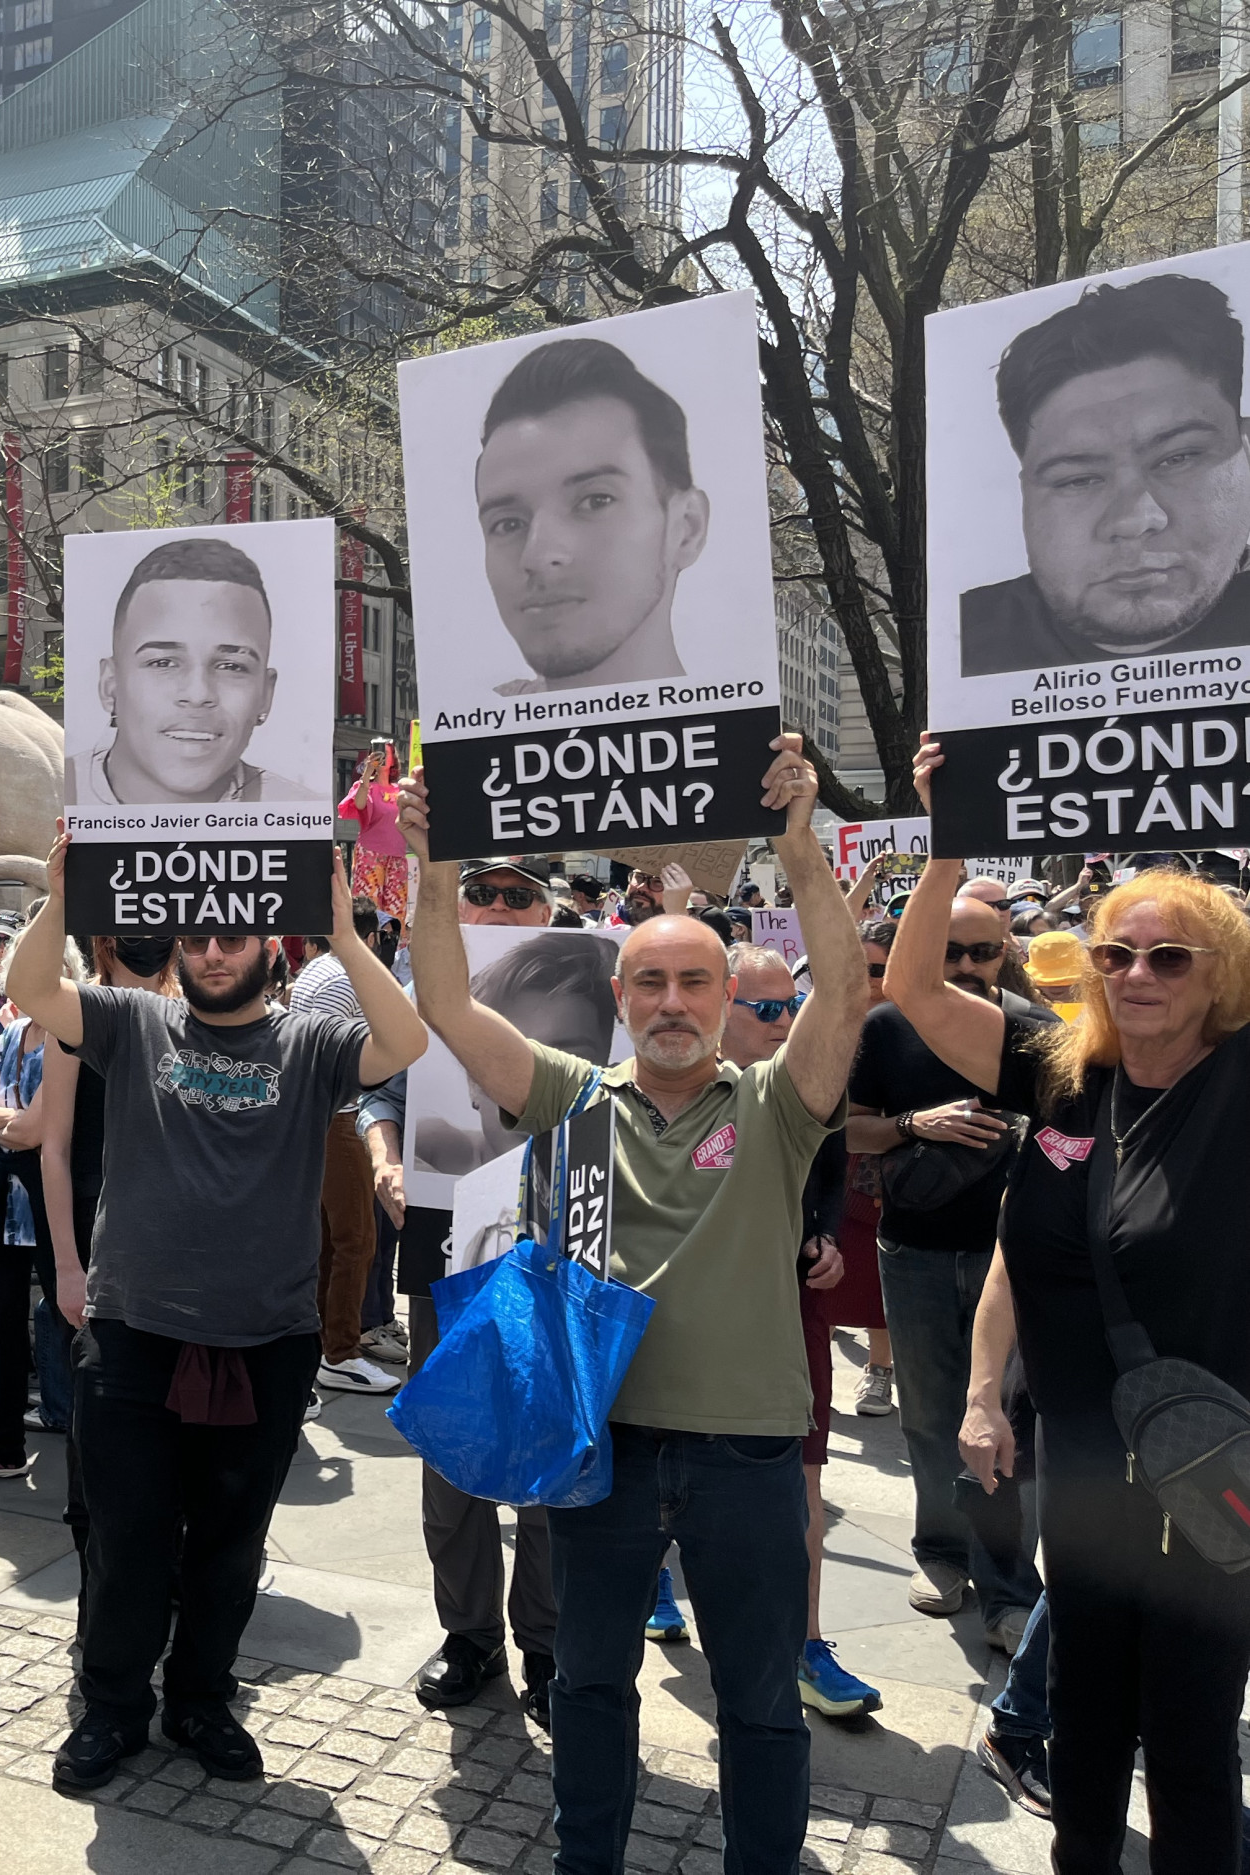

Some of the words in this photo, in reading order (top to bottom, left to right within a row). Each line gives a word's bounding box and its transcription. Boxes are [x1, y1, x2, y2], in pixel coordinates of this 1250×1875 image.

[344, 590, 357, 626] Public
[343, 632, 357, 683] Library
[1033, 669, 1101, 691] Alirio
[1111, 657, 1241, 682] Guillermo
[435, 708, 505, 730] Andry
[515, 692, 649, 721] Hernandez
[659, 681, 763, 705] Romero
[1012, 695, 1106, 716] Belloso
[483, 725, 718, 798] ¿DÓNDE
[998, 717, 1250, 793] ¿DÓND
[69, 816, 145, 829] Francisco
[151, 815, 200, 828] Javier
[205, 814, 257, 827] Garcia
[264, 813, 331, 828] Casique
[490, 780, 714, 840] ESTÁN?
[1007, 775, 1250, 840] ESTÁN
[839, 824, 897, 864] Fund
[110, 843, 287, 890] ¿DÓNDE
[115, 885, 282, 924] ESTÁN?
[755, 911, 787, 930] The
[218, 1079, 260, 1095] YEAR
[696, 1134, 726, 1164] GRAND
[721, 1129, 731, 1138] ST
[1042, 1132, 1081, 1155] GRAND
